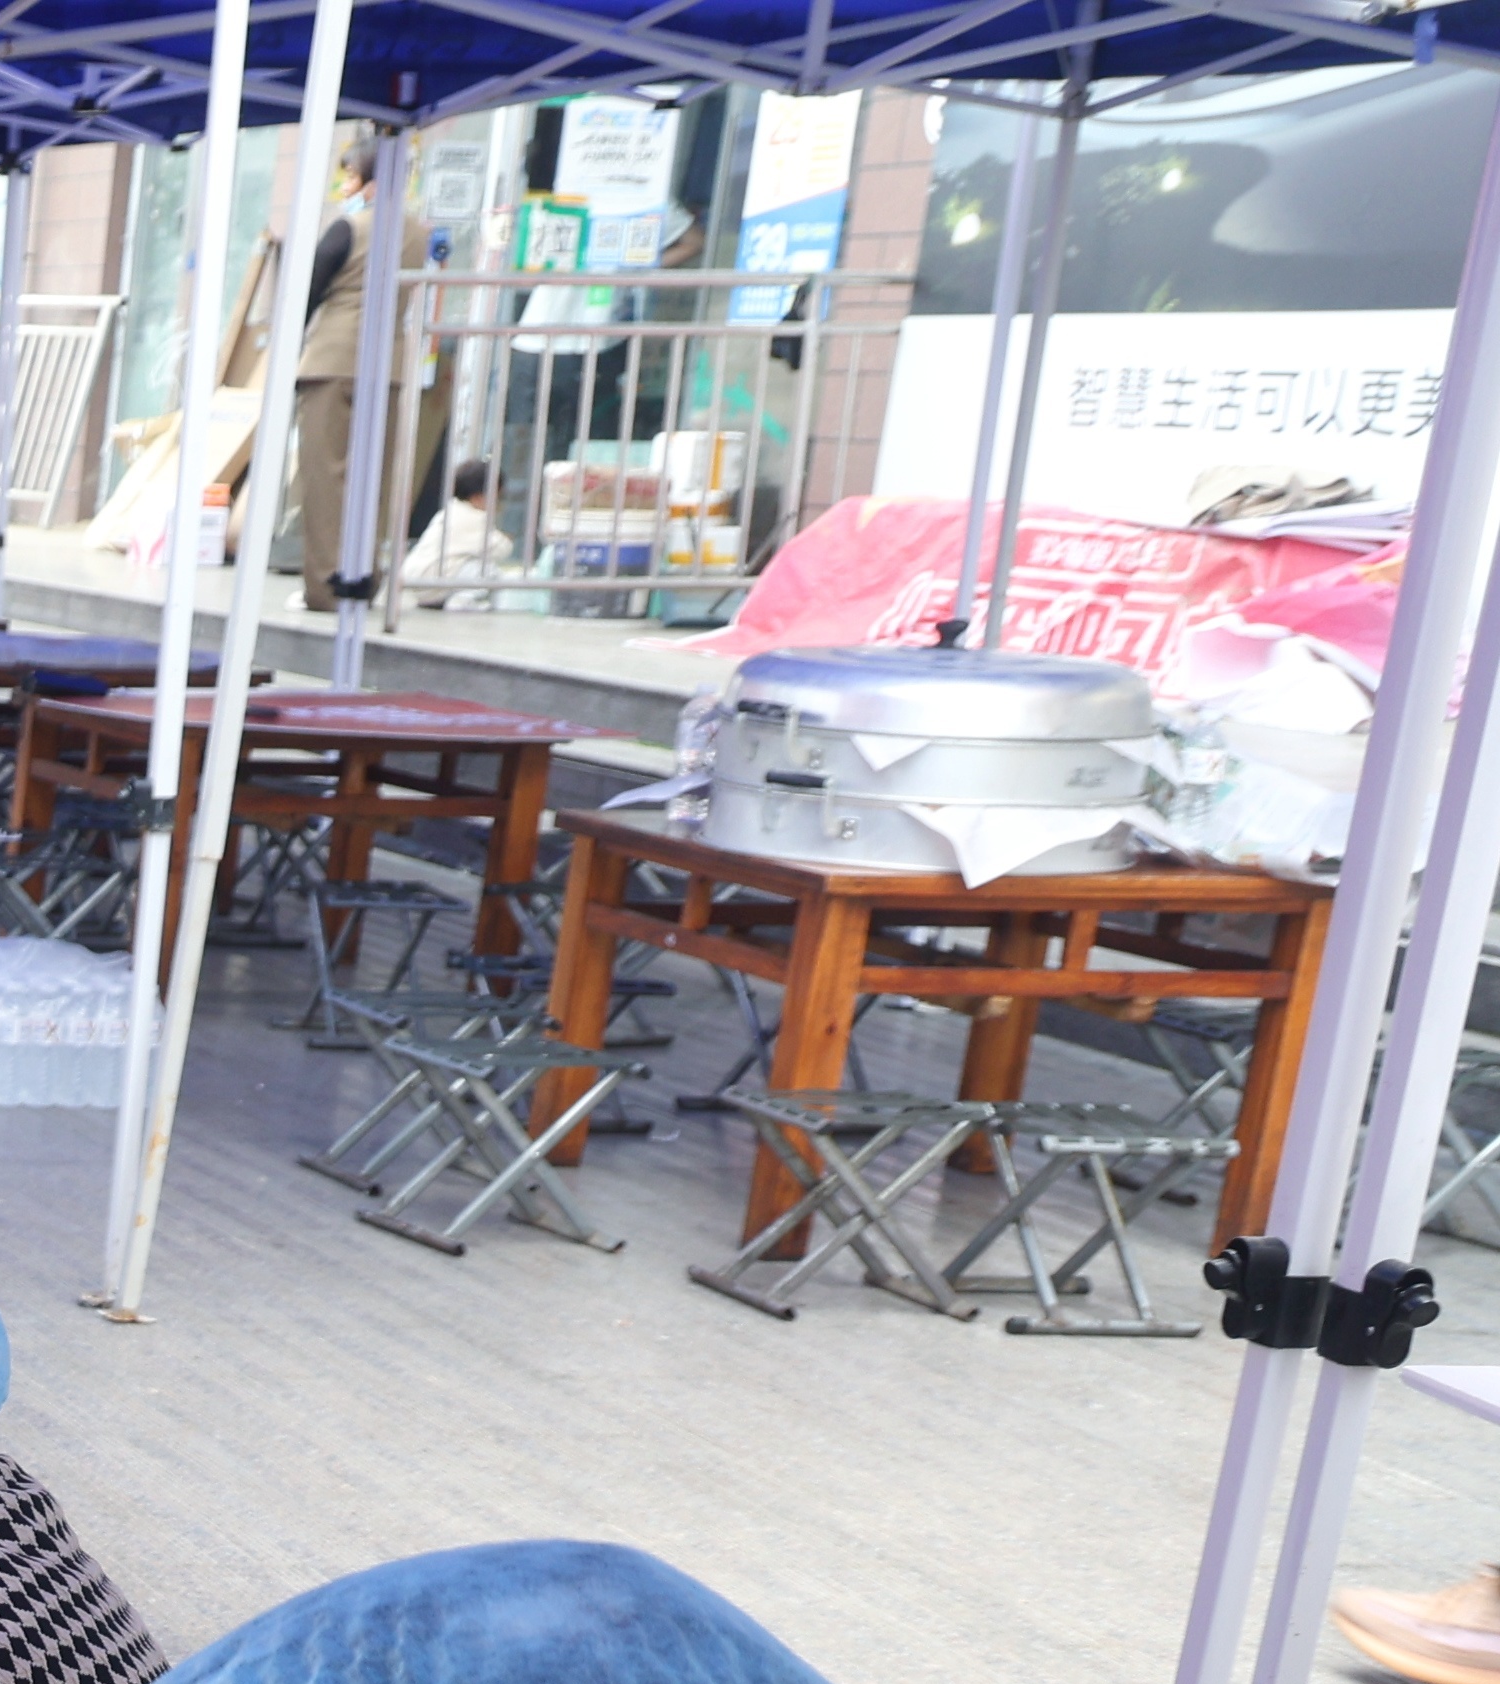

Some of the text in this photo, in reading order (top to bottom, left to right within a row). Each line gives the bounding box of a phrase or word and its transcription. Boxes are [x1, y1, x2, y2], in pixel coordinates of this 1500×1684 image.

[1068, 364, 1444, 438] 智慧生活可以更美
